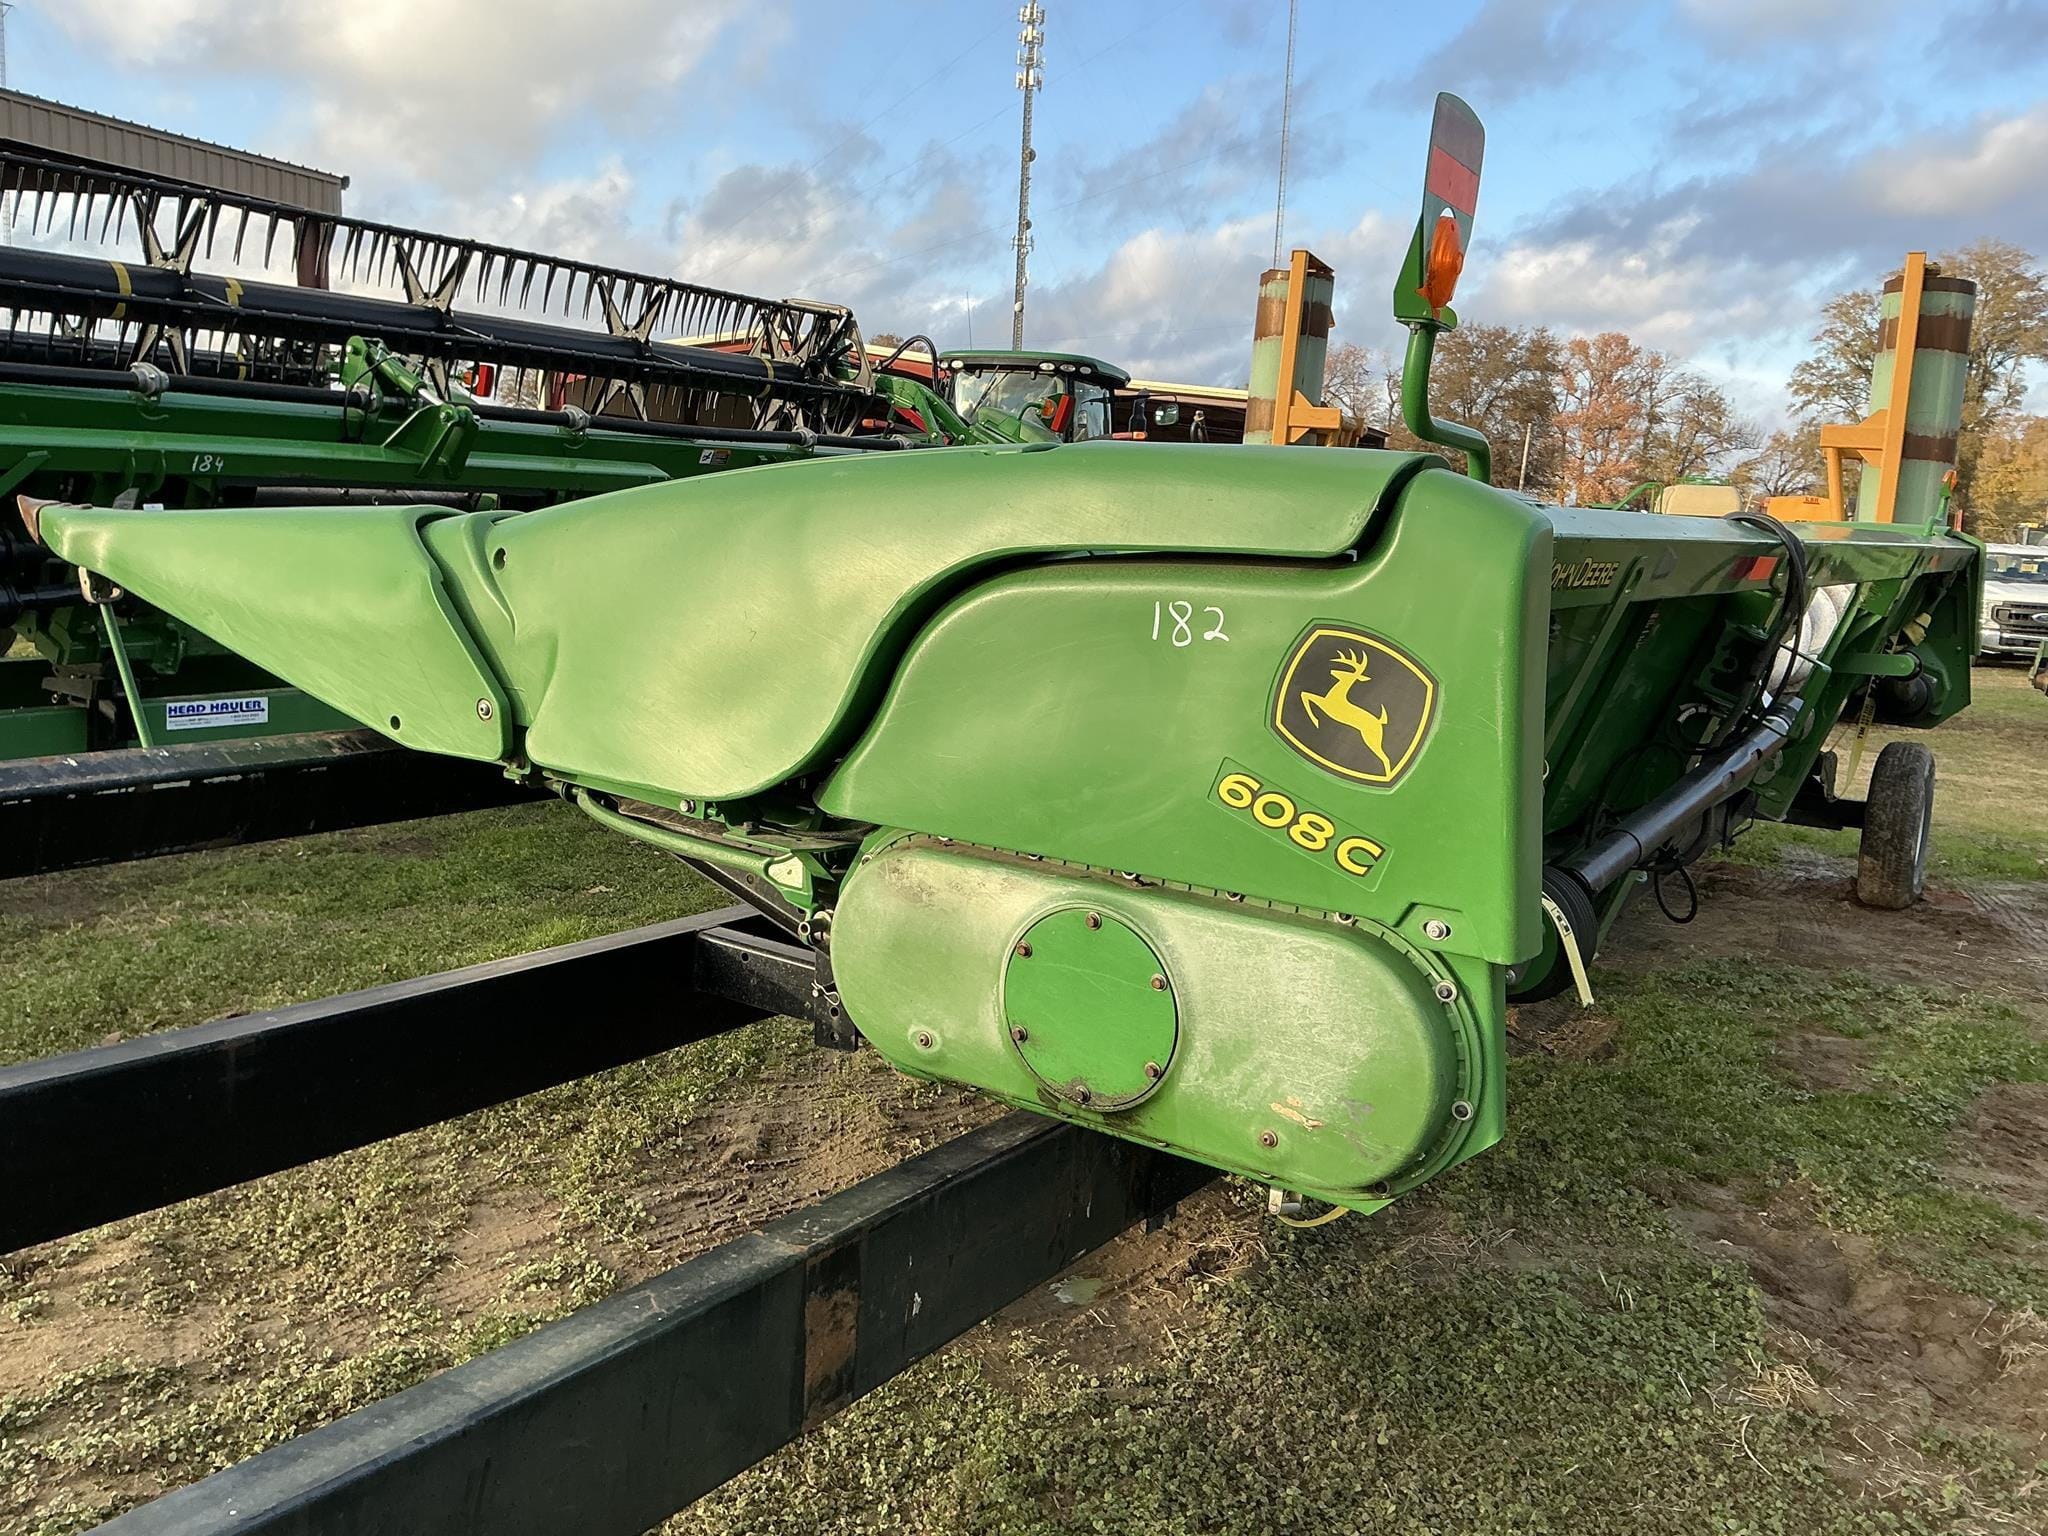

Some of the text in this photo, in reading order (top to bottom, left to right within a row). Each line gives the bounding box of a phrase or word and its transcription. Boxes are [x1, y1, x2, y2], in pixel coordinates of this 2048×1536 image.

[192, 454, 224, 473] 184
[1573, 557, 1620, 587] DEERE
[1151, 600, 1230, 647] 182
[168, 700, 262, 715] HEAD HAULER
